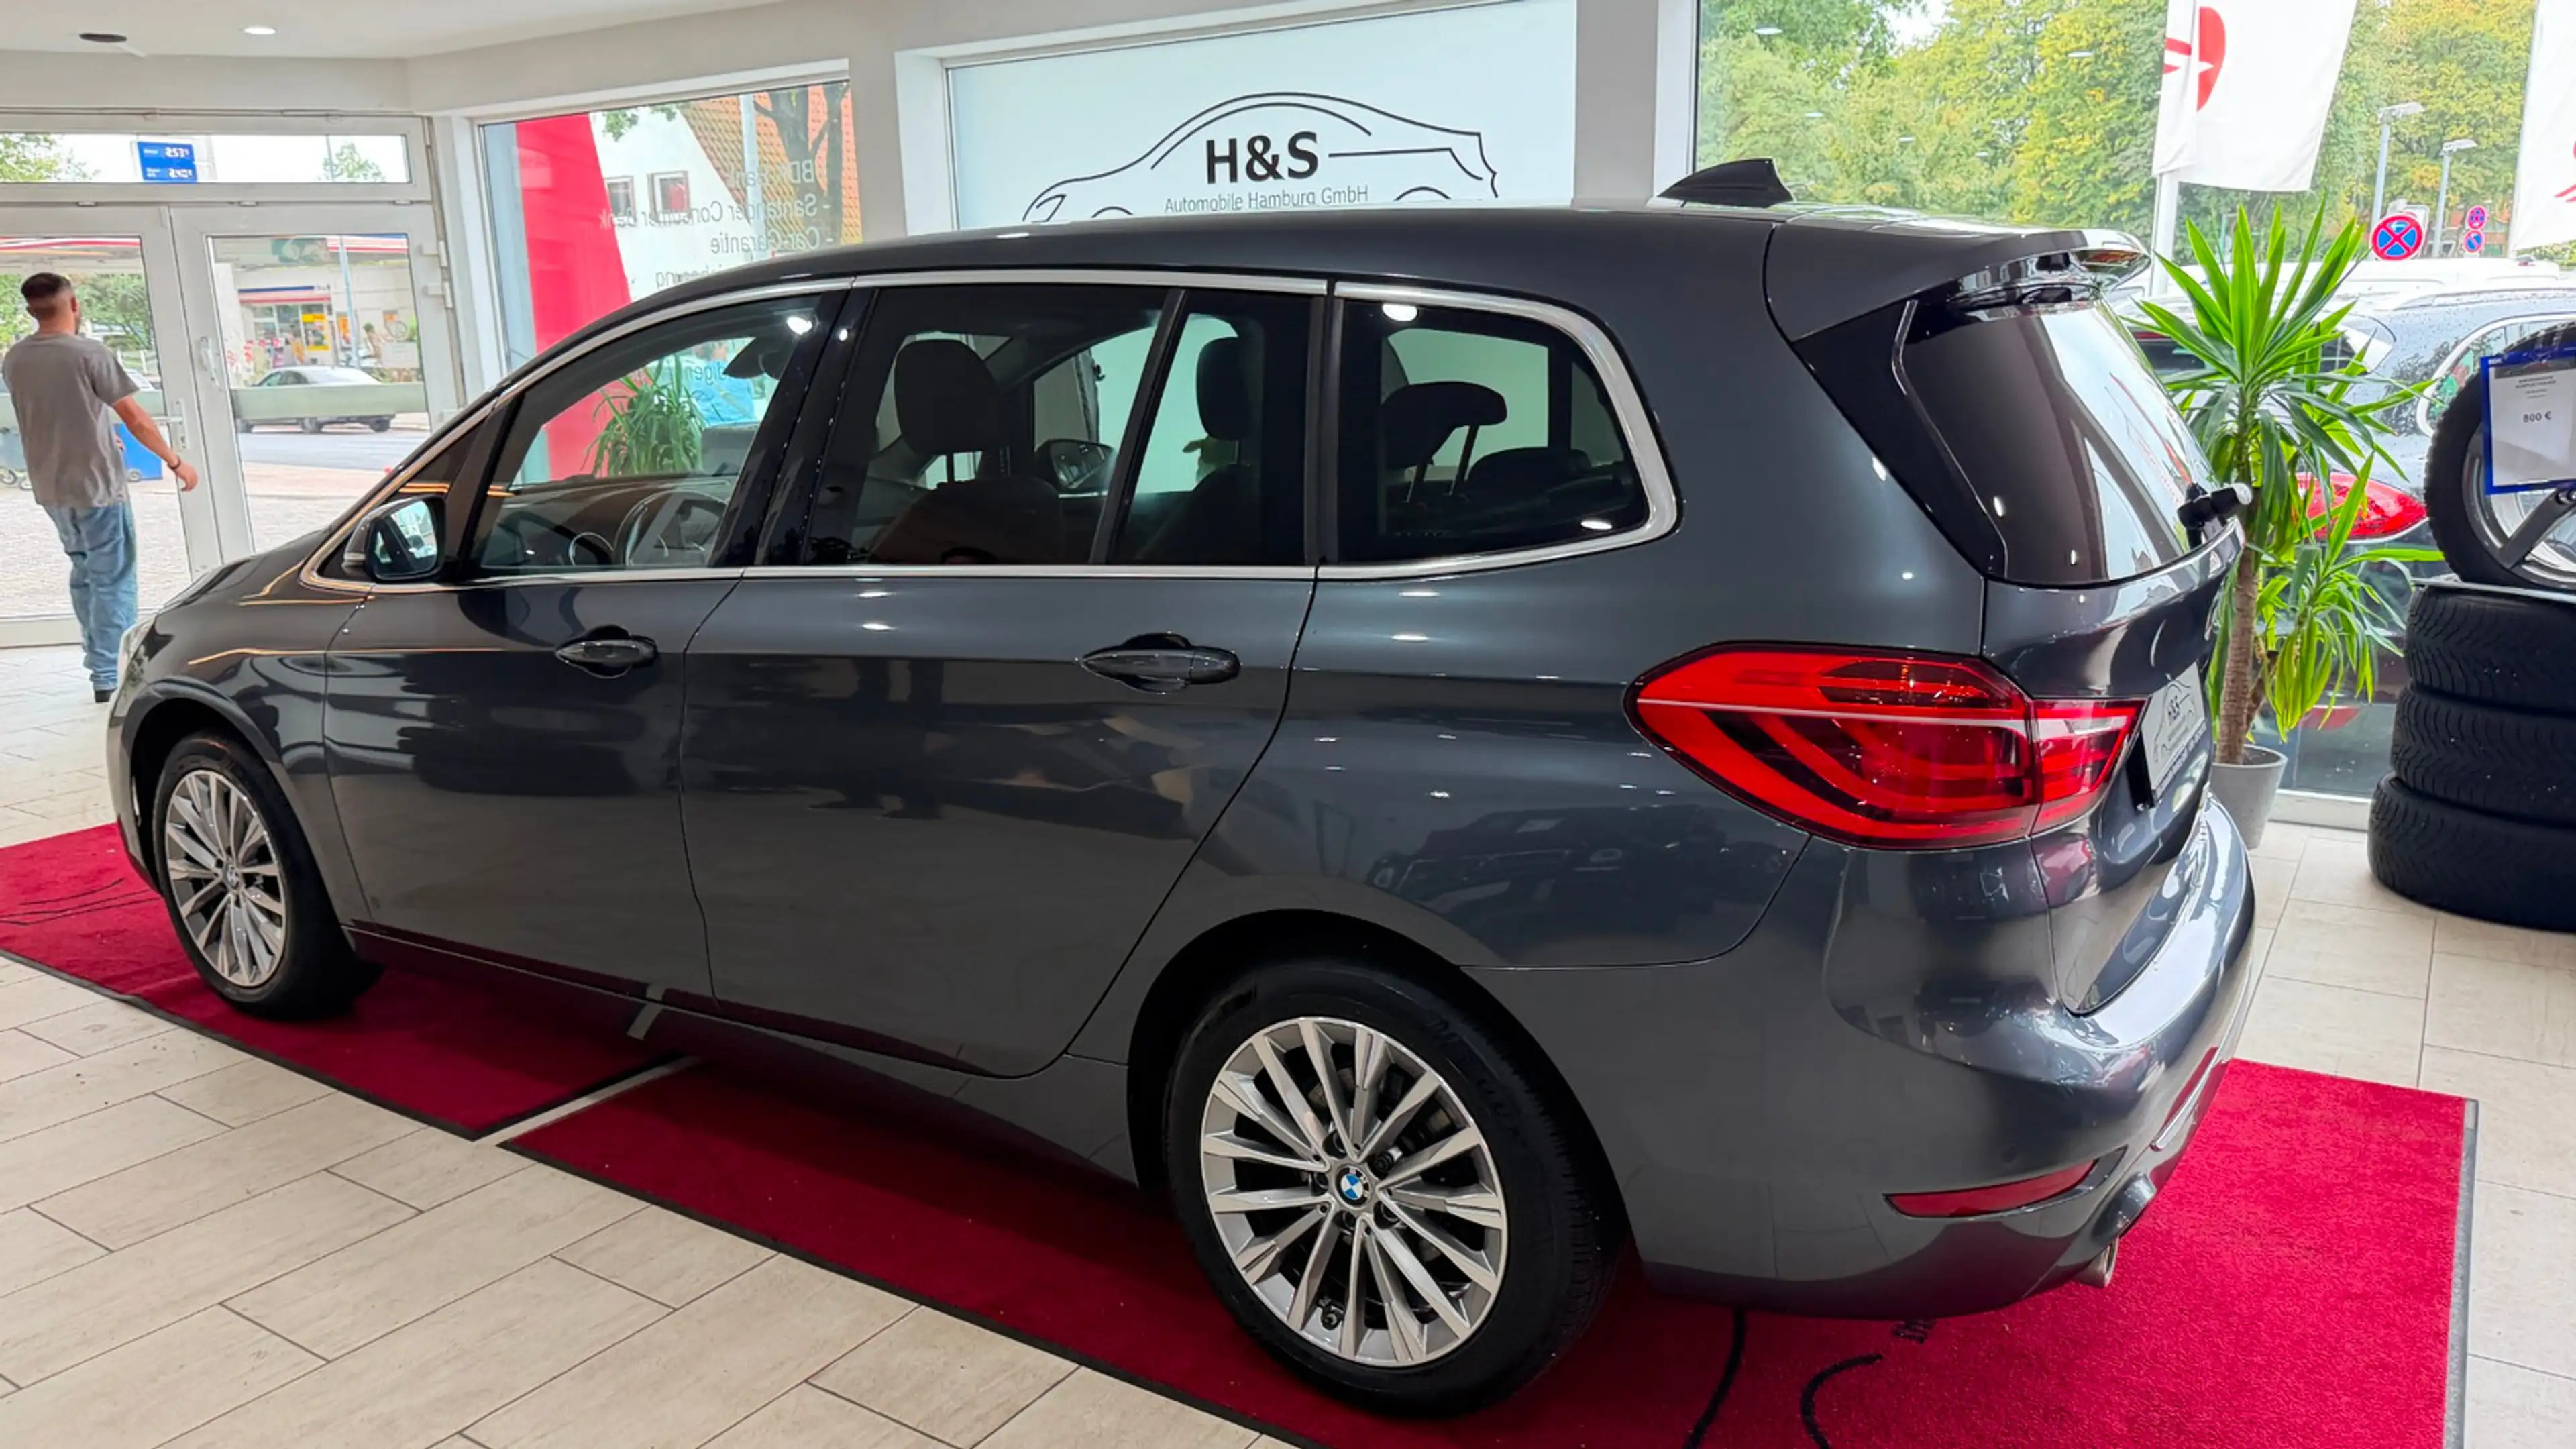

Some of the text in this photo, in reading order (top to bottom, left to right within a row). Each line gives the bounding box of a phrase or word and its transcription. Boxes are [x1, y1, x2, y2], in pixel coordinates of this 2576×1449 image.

[1206, 131, 1318, 184] H&S
[1165, 192, 1243, 213] Automobile
[1321, 185, 1368, 205] GmbH
[2523, 411, 2552, 423] 800 €
